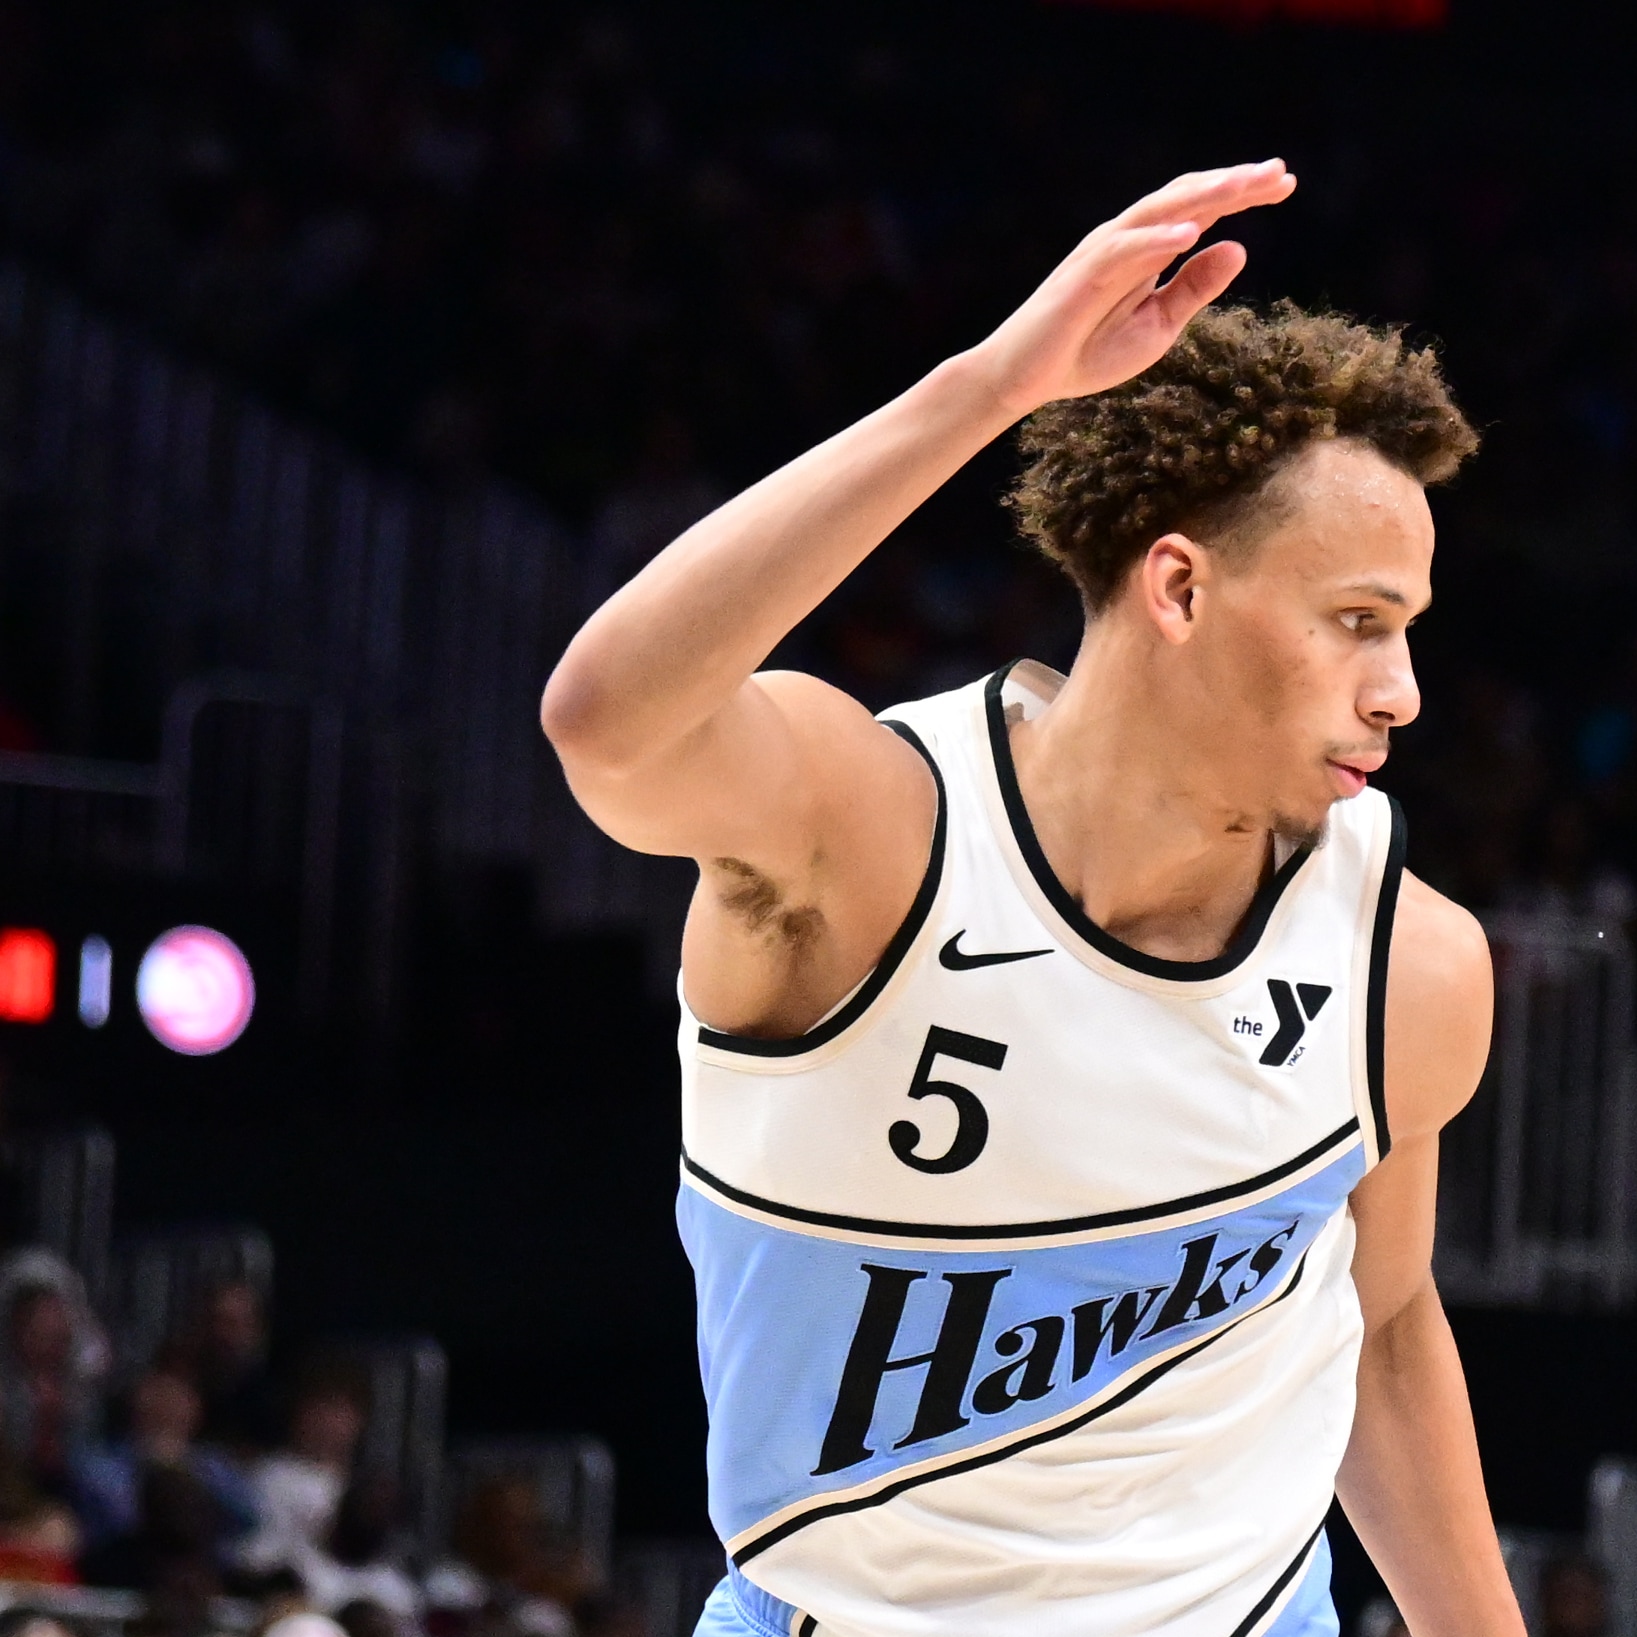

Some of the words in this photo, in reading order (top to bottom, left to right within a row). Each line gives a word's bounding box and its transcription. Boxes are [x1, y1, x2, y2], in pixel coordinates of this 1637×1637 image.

[1233, 1015, 1263, 1037] the
[1286, 1045, 1306, 1067] YMCA
[888, 1024, 1009, 1175] 5
[810, 1219, 1300, 1477] Hawks
